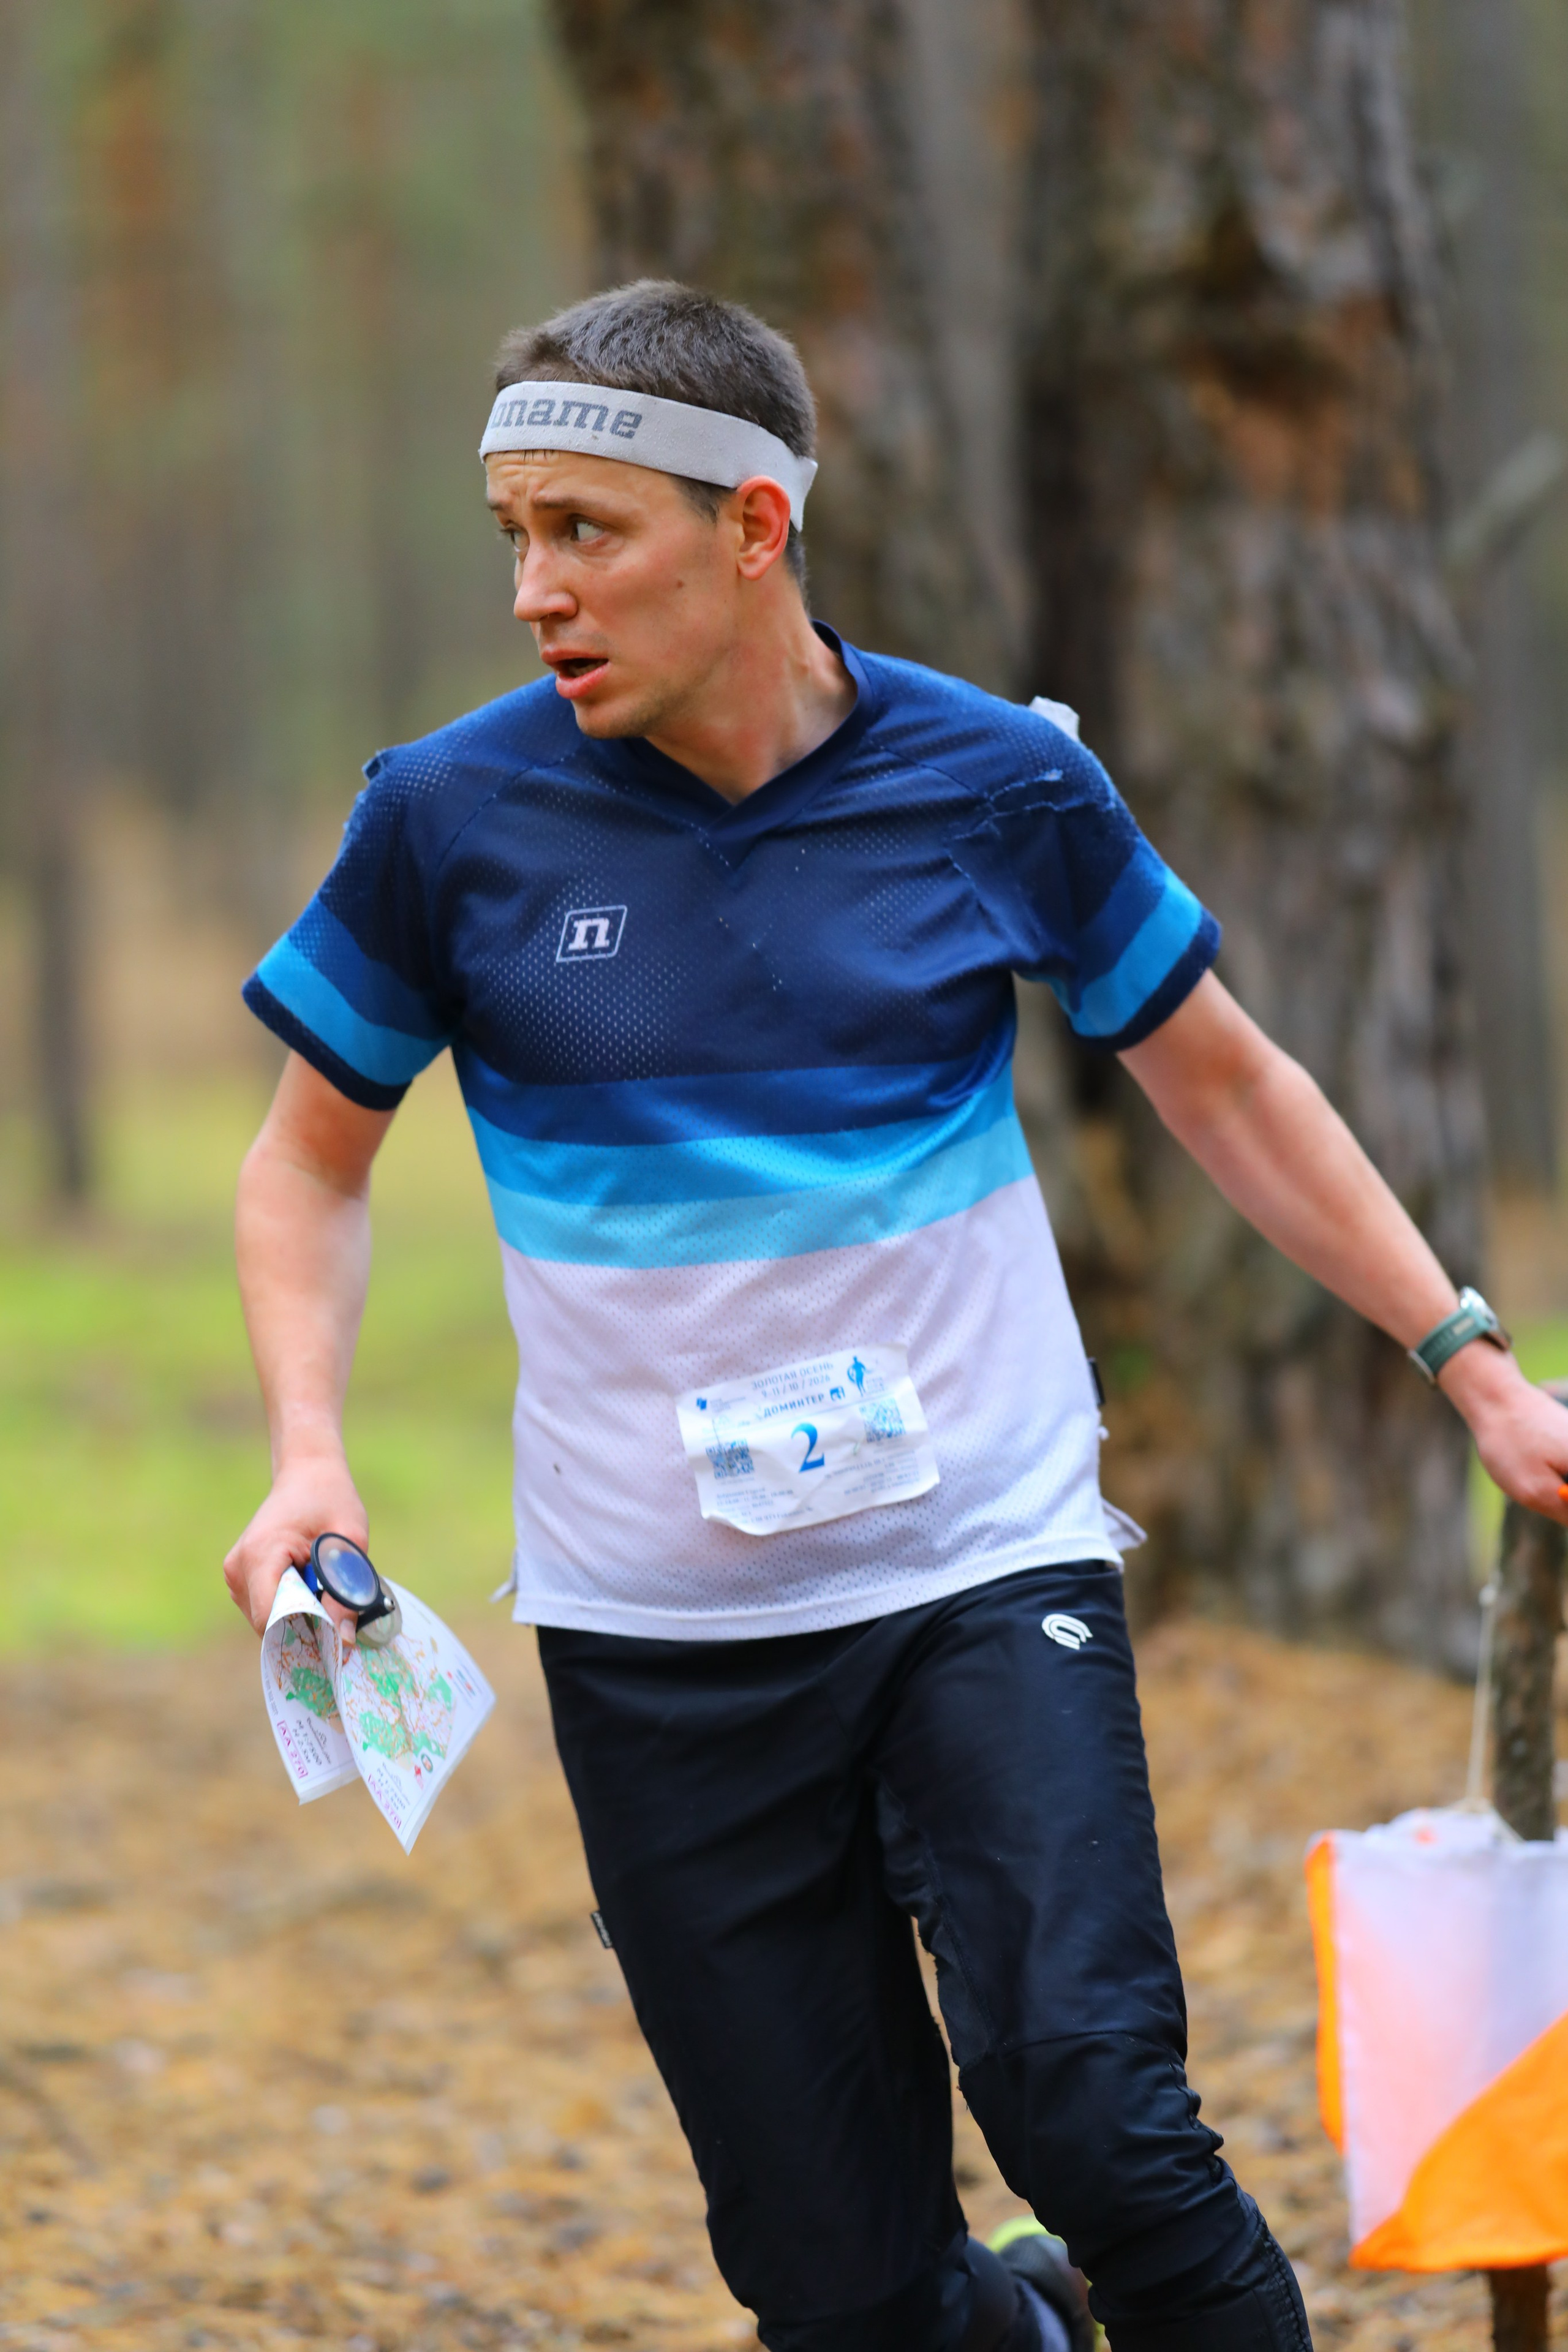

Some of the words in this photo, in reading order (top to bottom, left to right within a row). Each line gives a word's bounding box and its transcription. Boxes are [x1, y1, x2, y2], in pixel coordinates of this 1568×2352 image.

[490, 399, 643, 439] oname
[752, 1370, 797, 1391] ЗОЛОТАЯ
[799, 1361, 834, 1377] ОСЕНЬ
[763, 1393, 824, 1419] ДОМИНТЕР
[791, 1422, 825, 1473] 2
